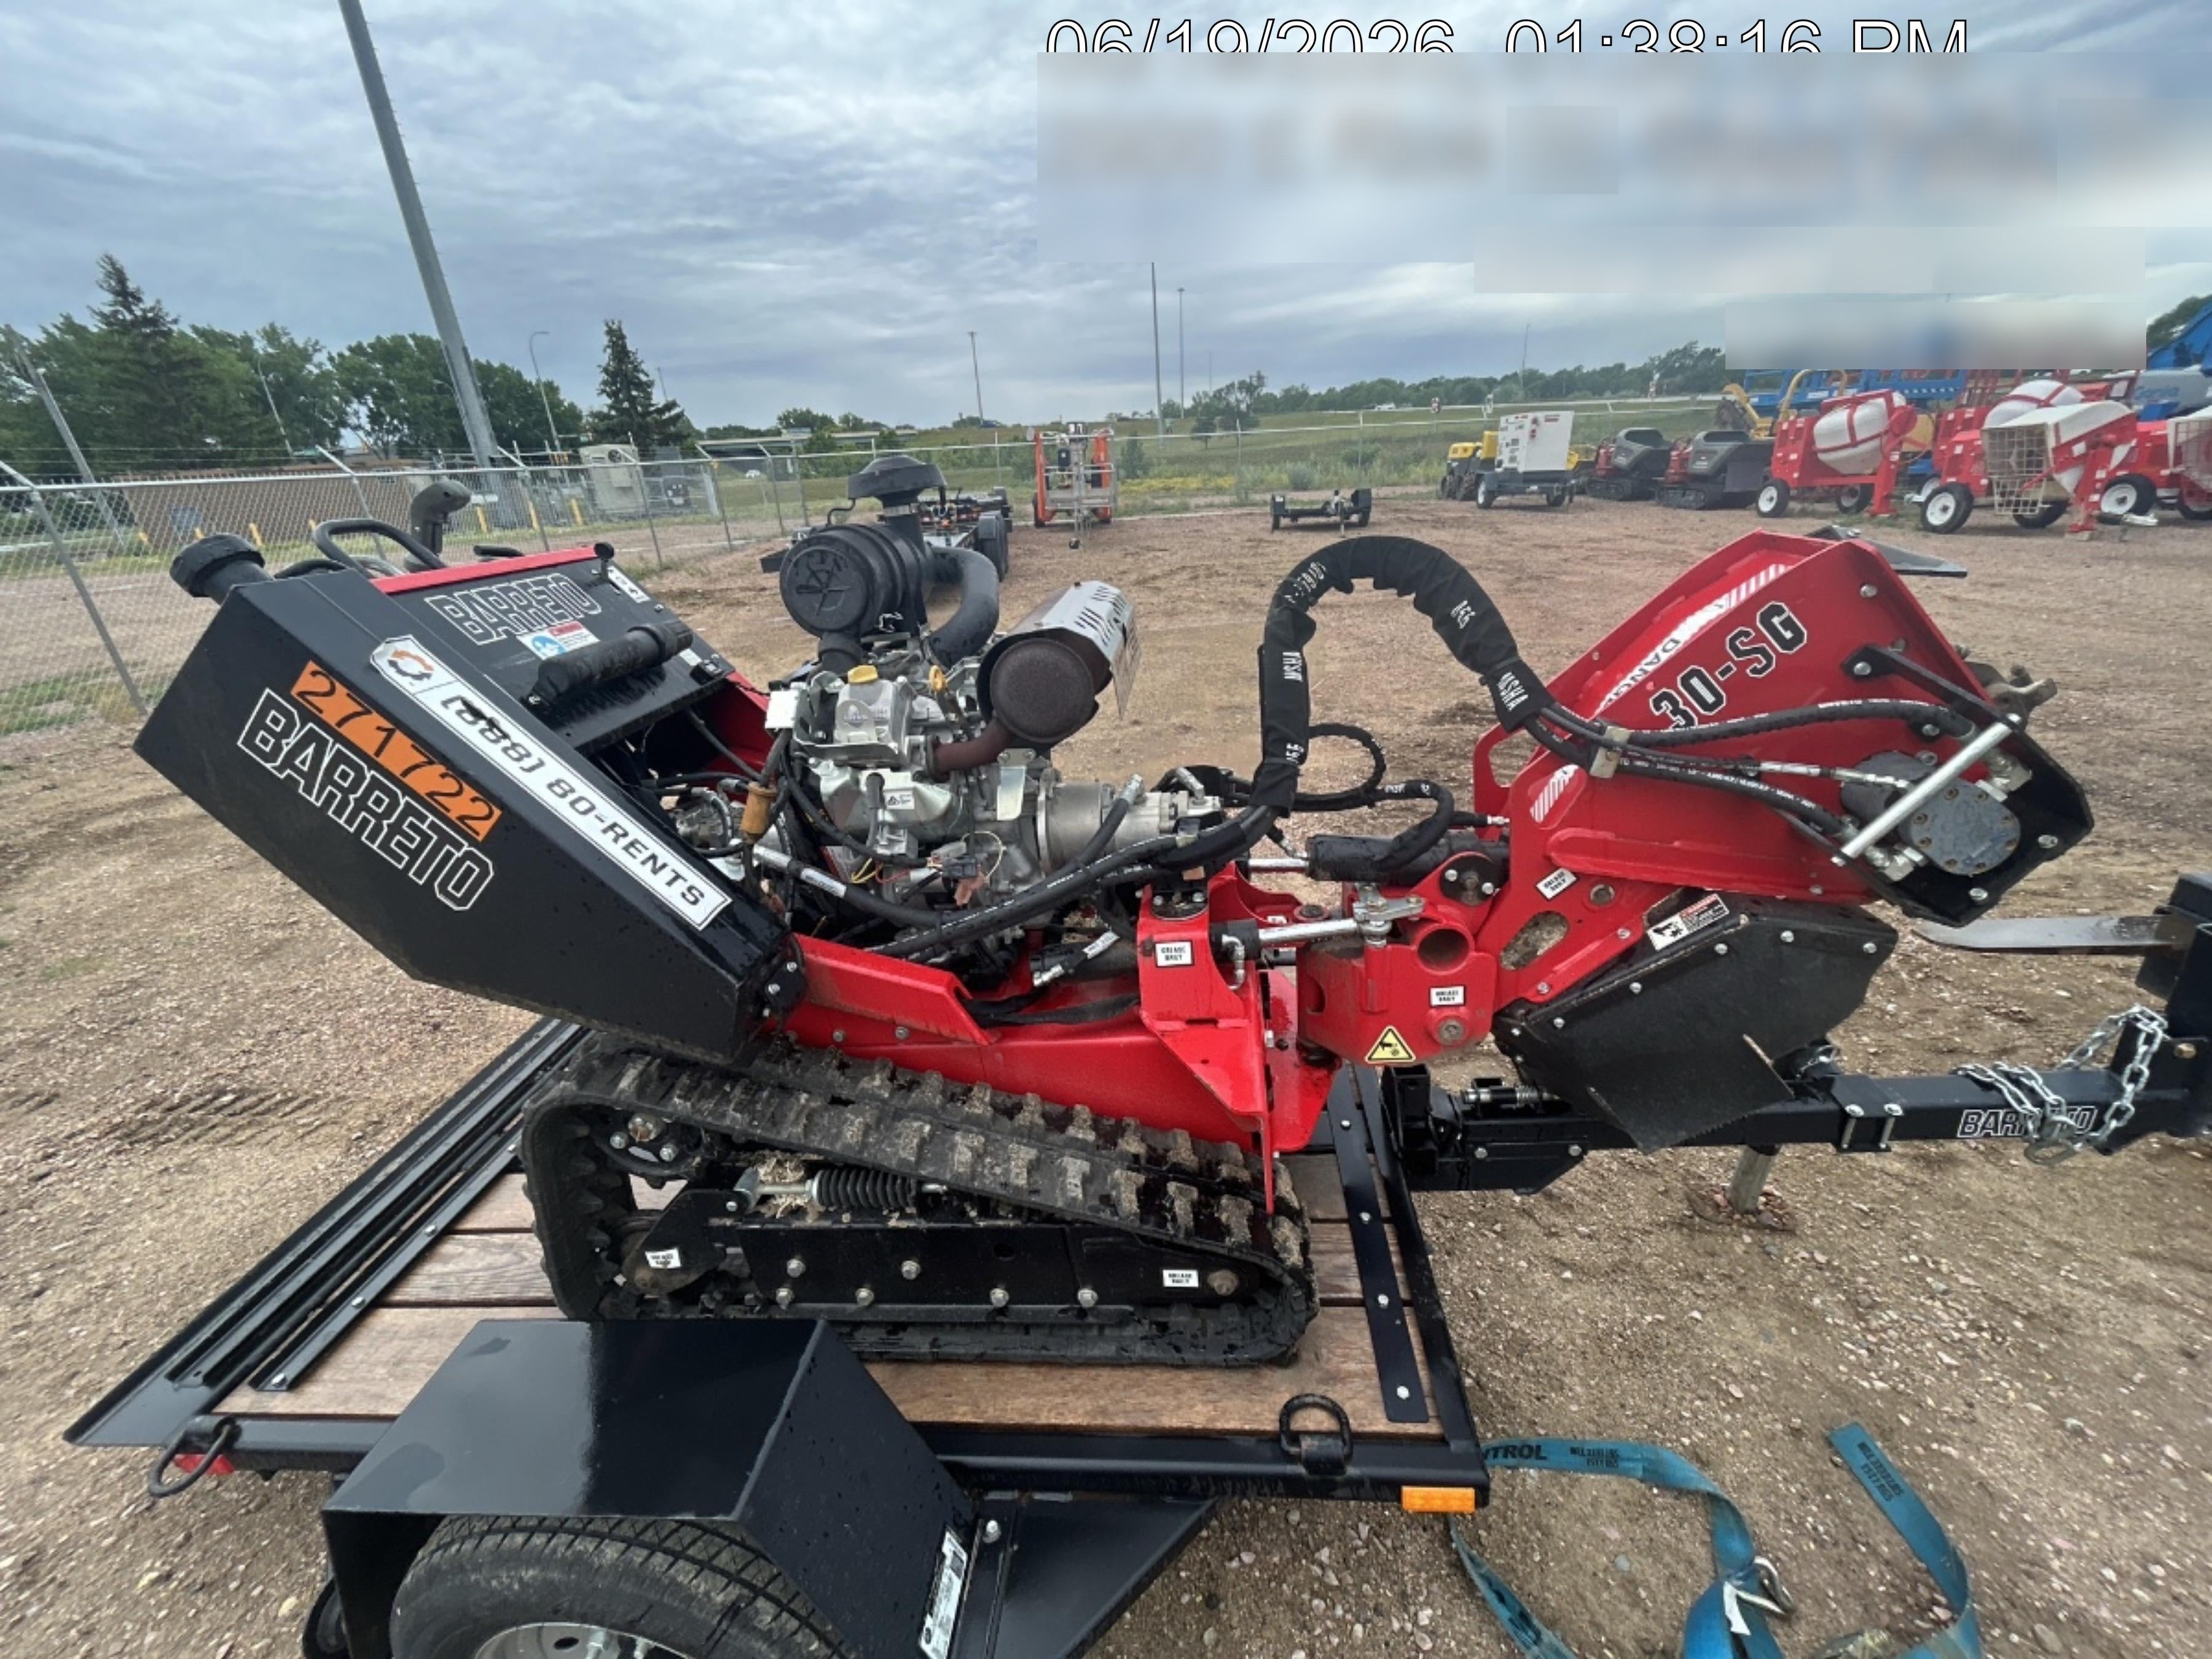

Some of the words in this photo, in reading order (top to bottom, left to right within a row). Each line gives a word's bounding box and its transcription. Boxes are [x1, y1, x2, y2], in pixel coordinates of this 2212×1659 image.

[423, 572, 602, 646] BARRETO
[1649, 600, 1808, 729] 30-SG
[237, 687, 495, 911] BARRETO
[296, 670, 493, 837] 271722
[546, 777, 705, 906] 80-RENTS
